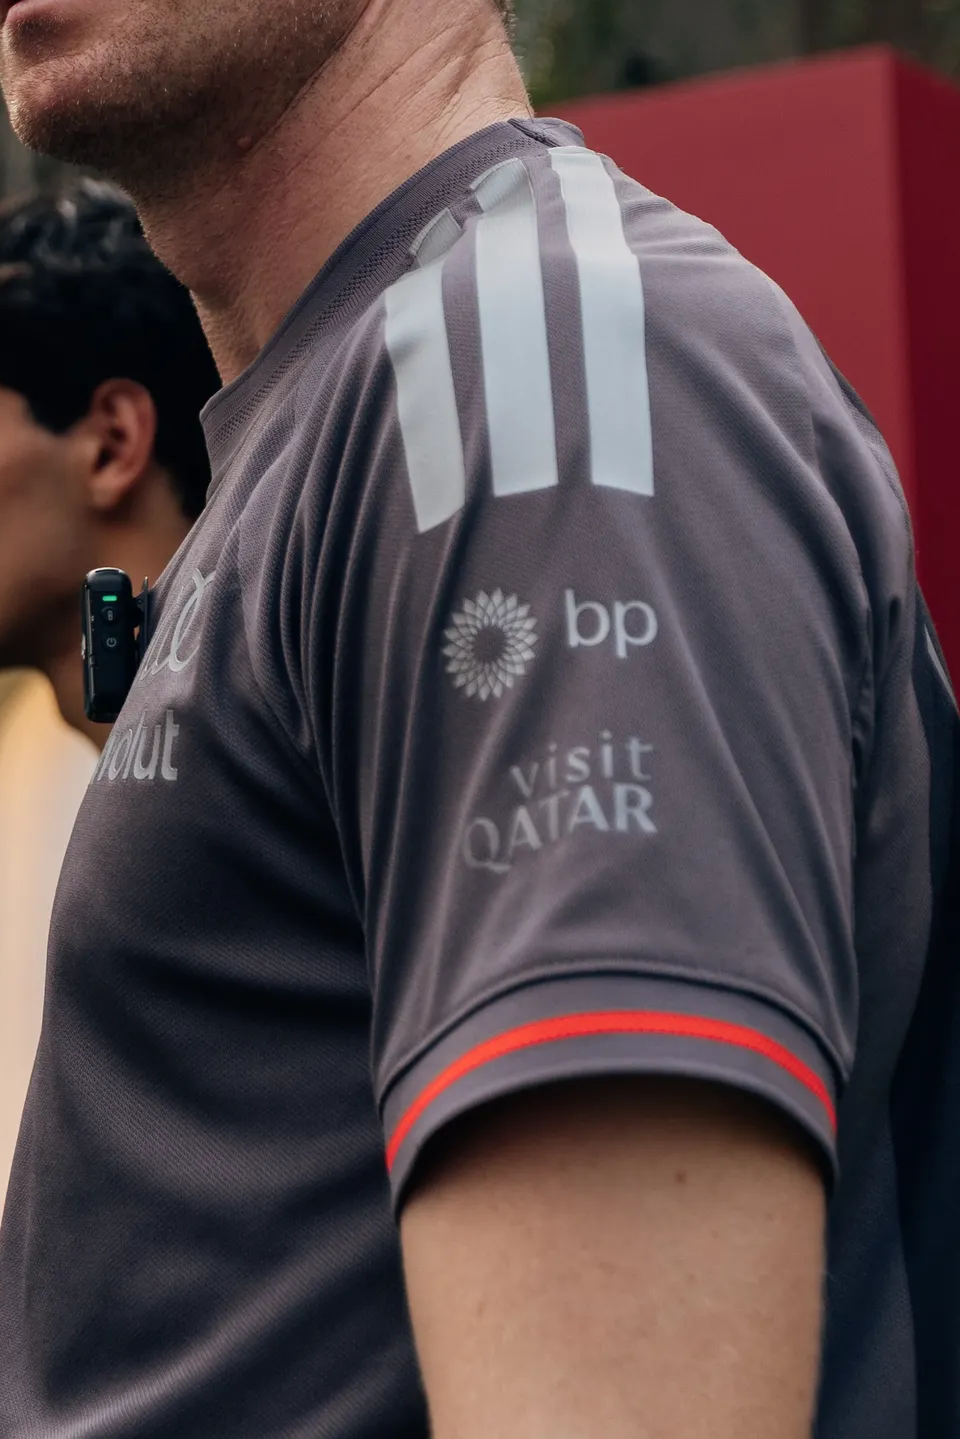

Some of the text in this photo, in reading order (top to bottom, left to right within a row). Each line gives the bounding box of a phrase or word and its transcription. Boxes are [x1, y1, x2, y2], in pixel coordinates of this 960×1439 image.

[565, 588, 658, 658] bp
[509, 729, 653, 798] visit
[463, 782, 658, 875] QATAR
